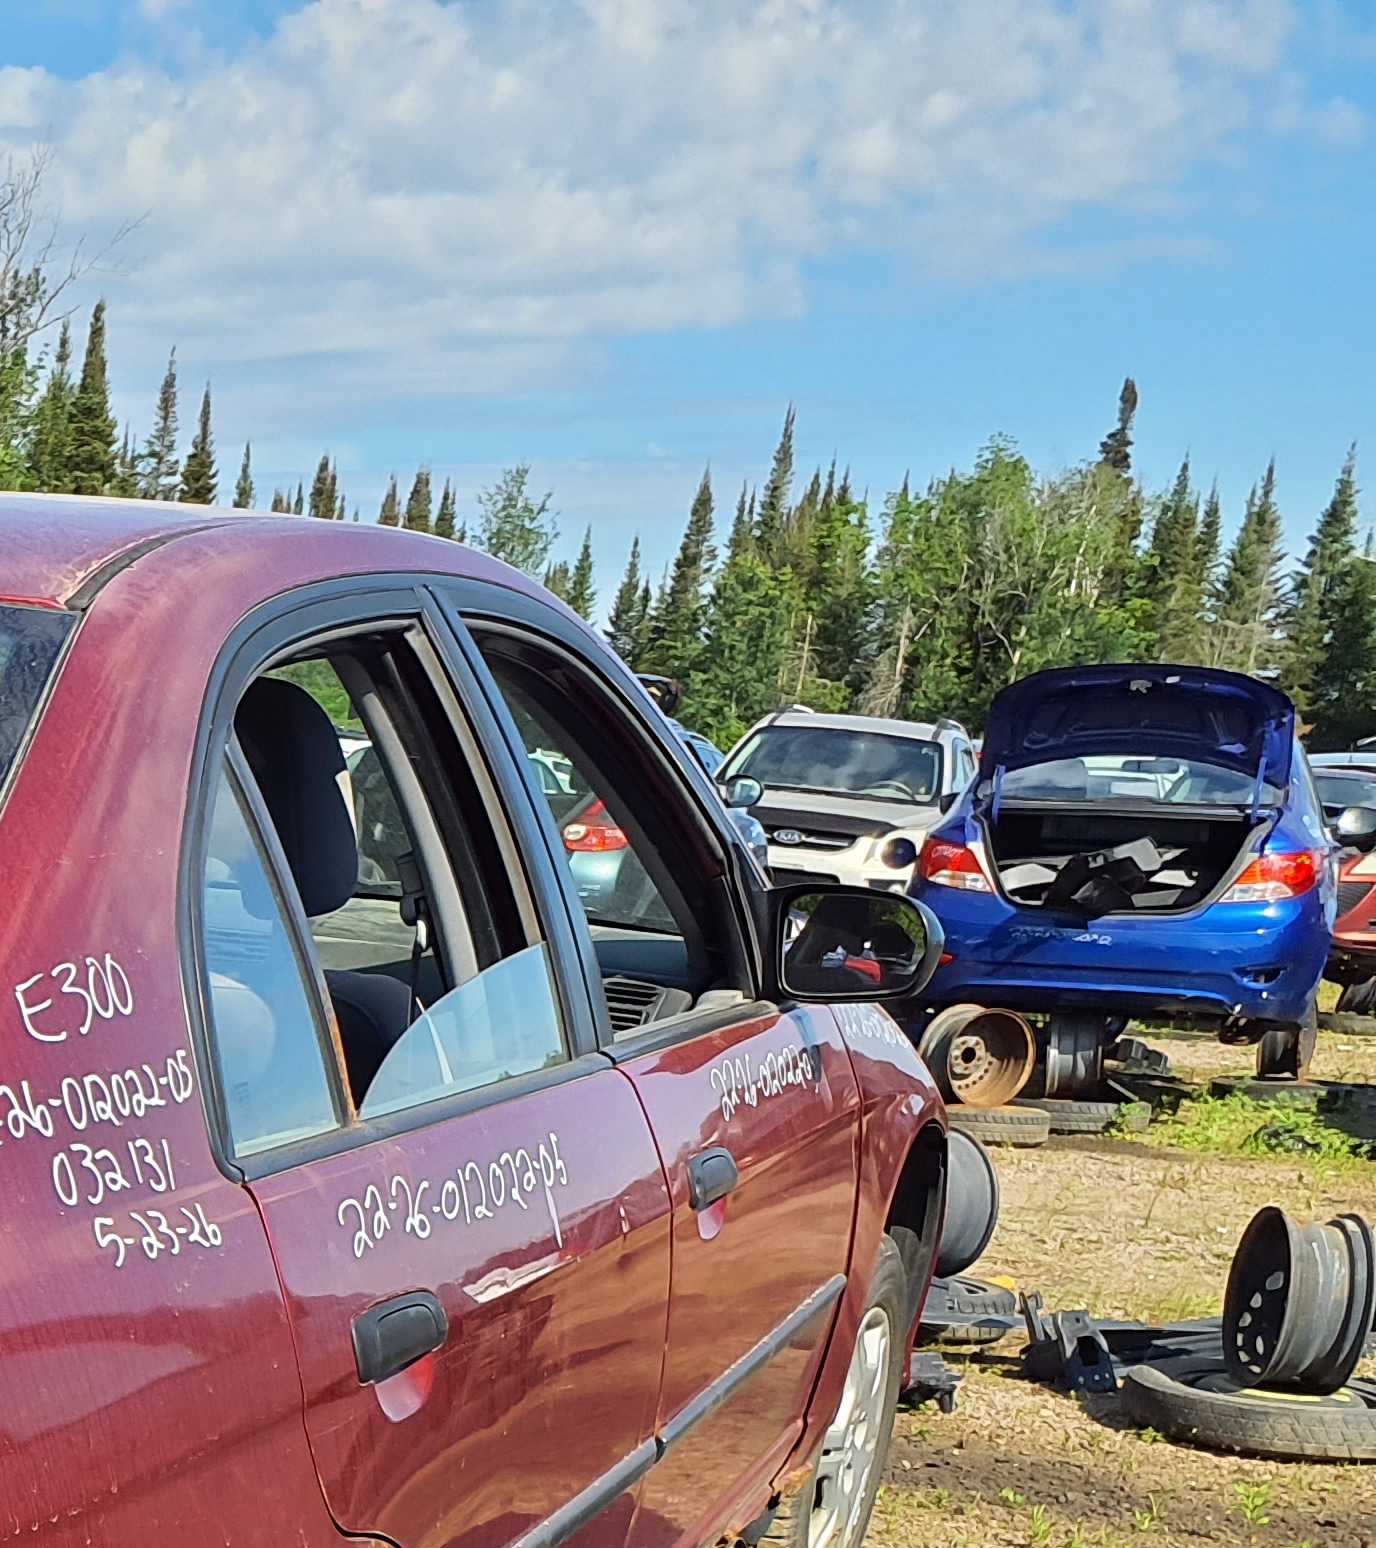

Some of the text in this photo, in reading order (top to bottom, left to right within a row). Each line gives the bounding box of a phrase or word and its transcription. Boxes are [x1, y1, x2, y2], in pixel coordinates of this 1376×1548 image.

[14, 952, 134, 1042] E300
[52, 1138, 177, 1207] 032131
[94, 1203, 223, 1267] 5-23-26
